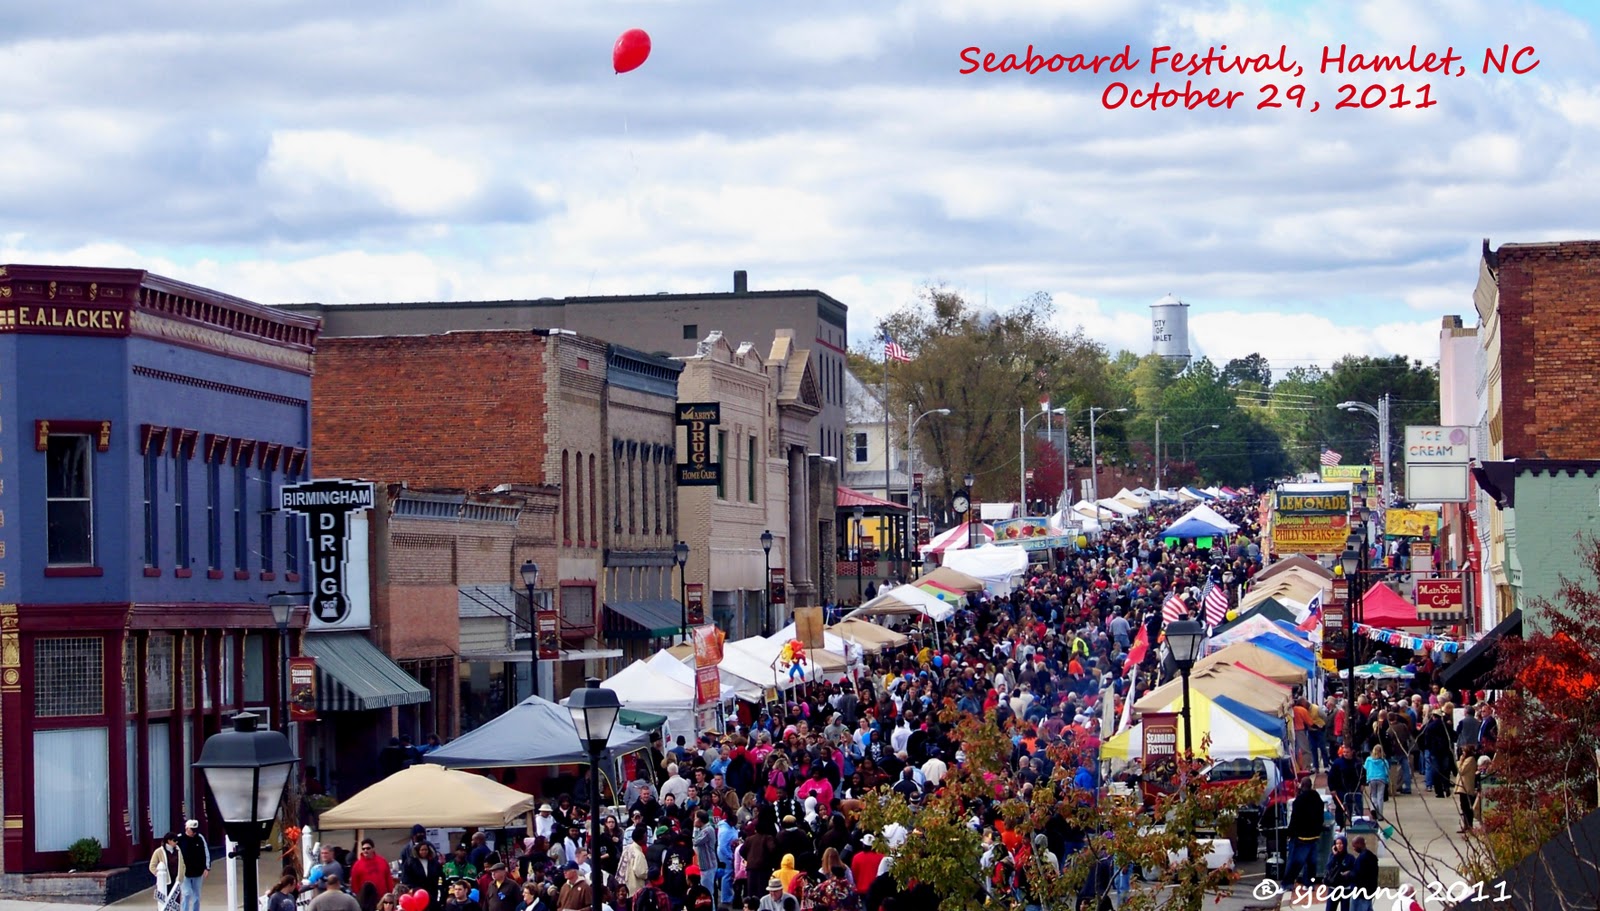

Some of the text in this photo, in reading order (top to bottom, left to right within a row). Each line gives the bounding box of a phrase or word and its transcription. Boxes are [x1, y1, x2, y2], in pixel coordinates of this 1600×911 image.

[1421, 431, 1442, 441] ICE
[692, 421, 705, 463] DRUG
[1409, 445, 1453, 456] CREAM
[283, 490, 370, 506] BIRMINGHAM
[1280, 495, 1347, 510] LEMONADE
[1275, 530, 1299, 541] PHILLY
[1302, 530, 1331, 541] STEAKS
[320, 513, 338, 595] DRUG
[1419, 585, 1440, 595] Main
[1146, 733, 1175, 743] SEABOARD
[1147, 744, 1174, 754] FESTIVAL
